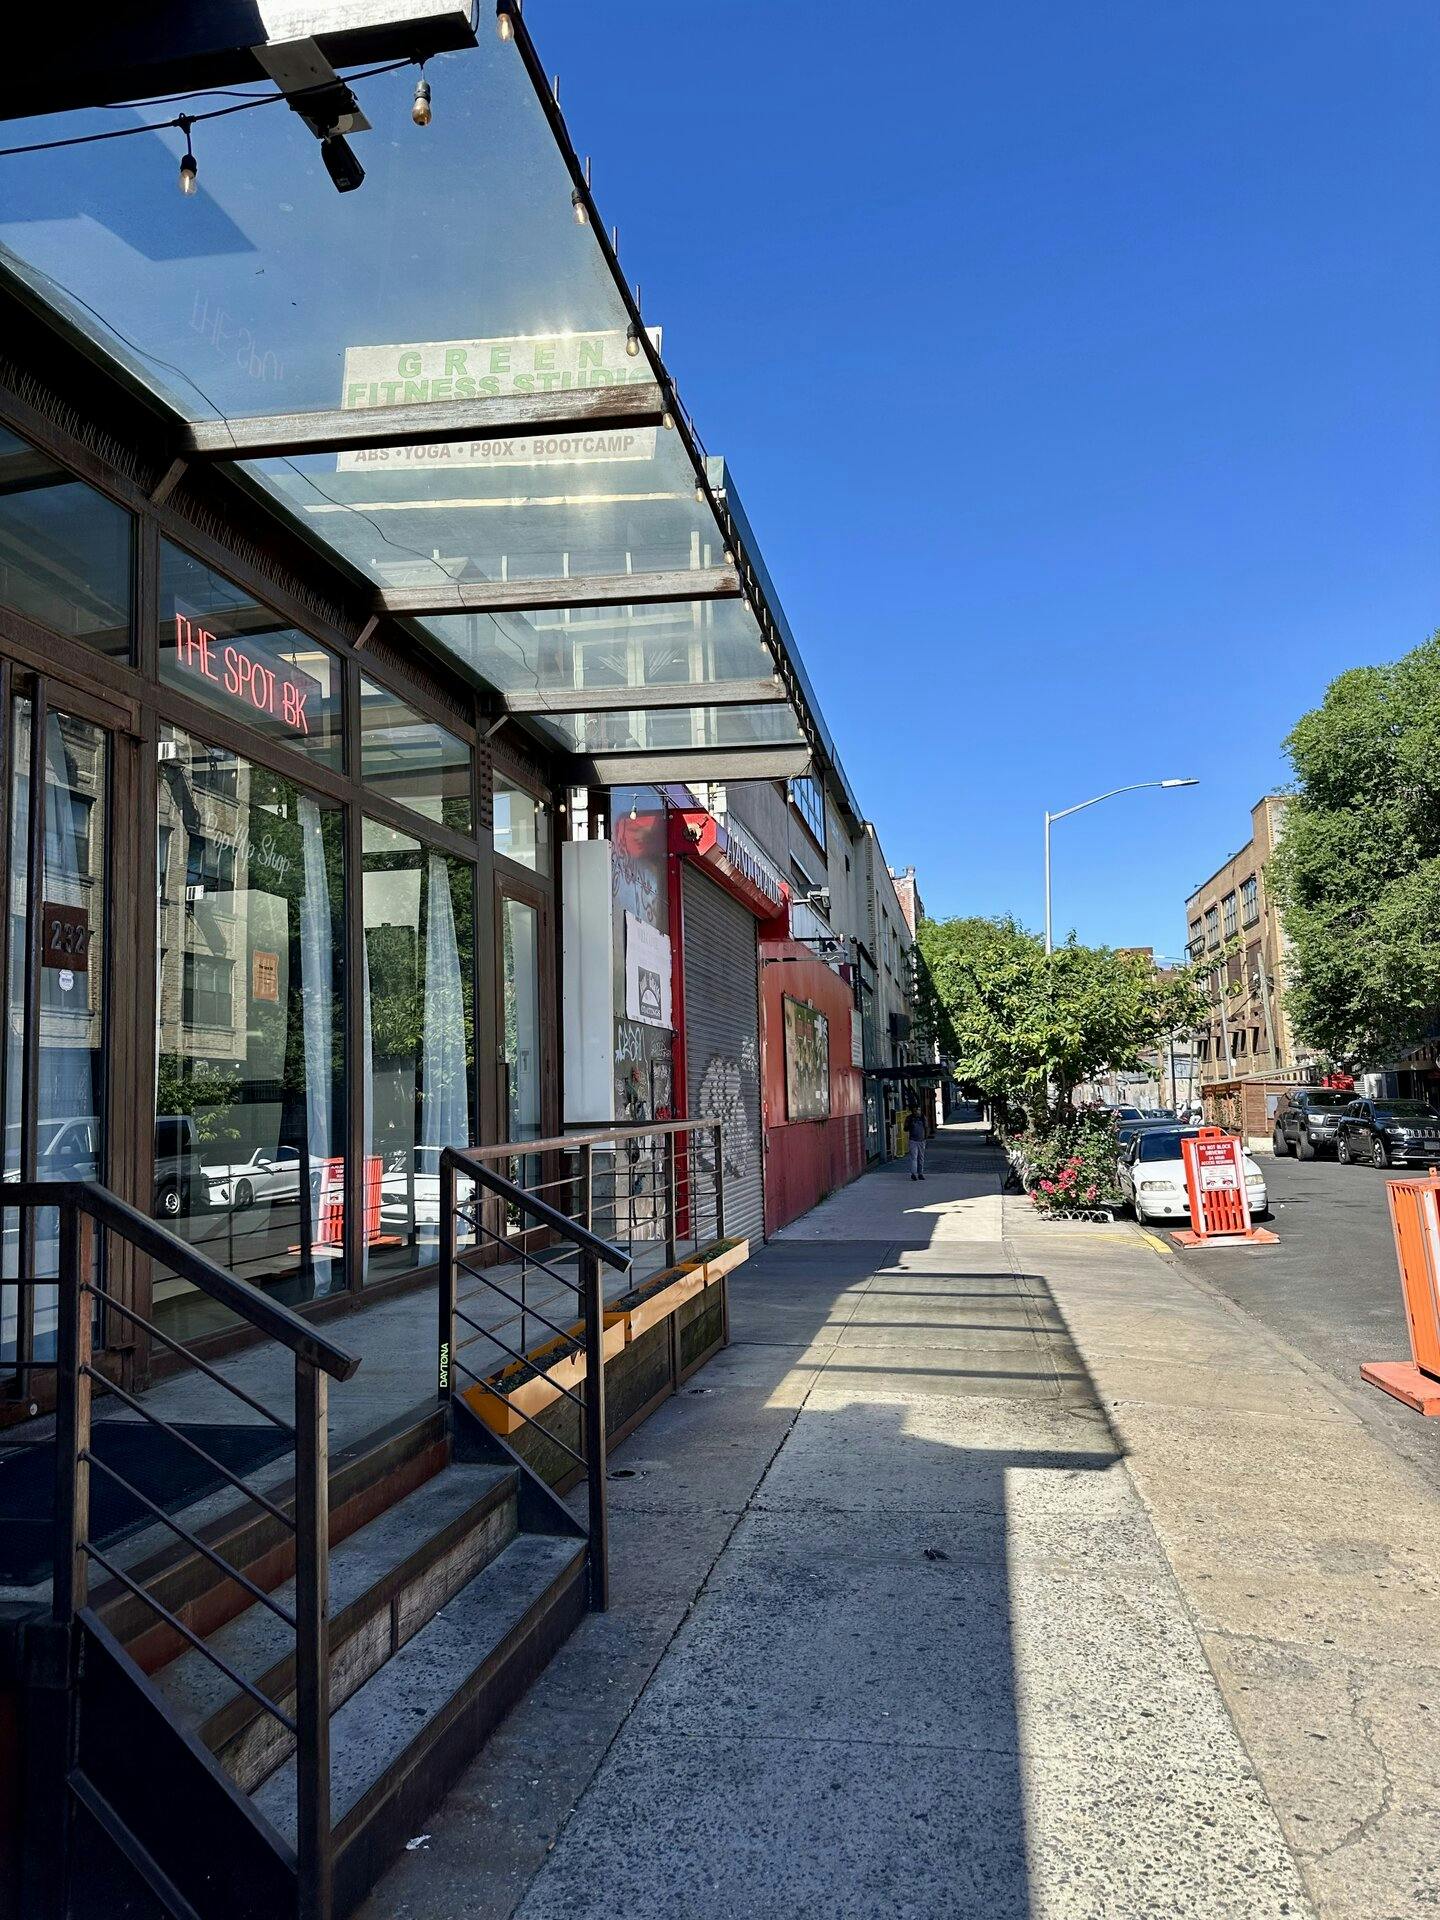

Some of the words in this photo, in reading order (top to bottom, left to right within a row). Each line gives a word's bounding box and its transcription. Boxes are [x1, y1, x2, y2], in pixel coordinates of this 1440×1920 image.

[397, 340, 604, 378] GREEN
[347, 376, 501, 407] FITNESS
[404, 444, 451, 460] YOGA
[469, 440, 514, 457] P90X
[533, 435, 635, 454] BOOTCAMP
[176, 612, 219, 681] THE
[223, 646, 276, 713] SPOT
[282, 681, 309, 734] BK
[50, 920, 87, 954] 232
[440, 1342, 449, 1388] DAYTONA
